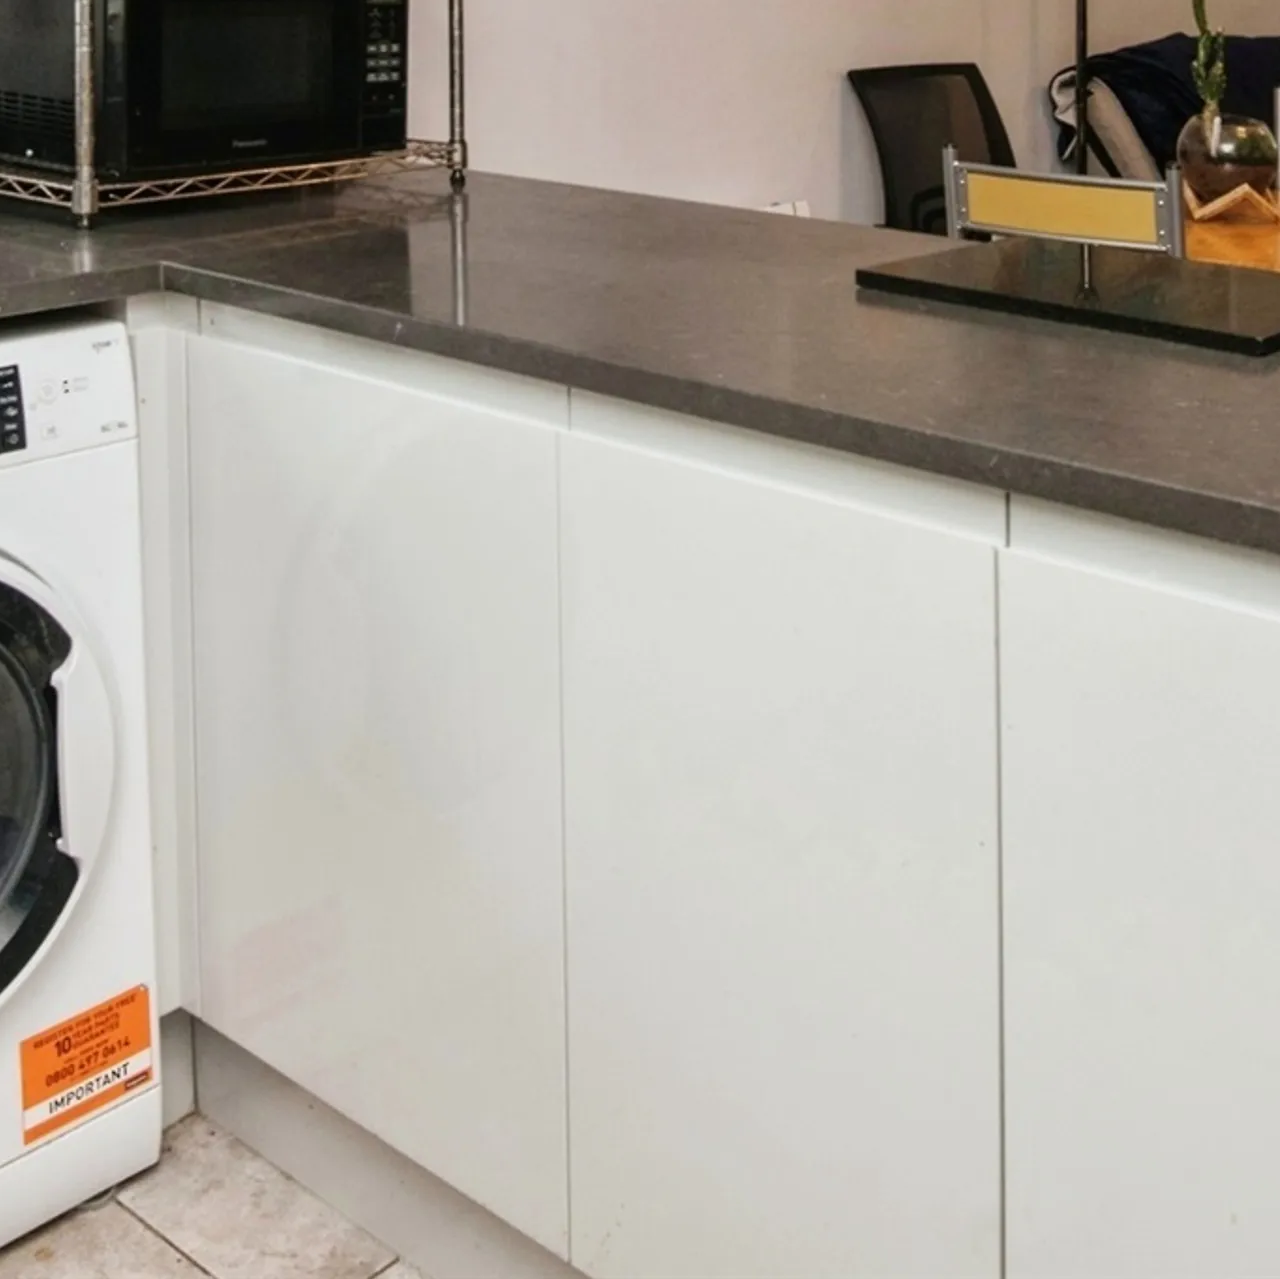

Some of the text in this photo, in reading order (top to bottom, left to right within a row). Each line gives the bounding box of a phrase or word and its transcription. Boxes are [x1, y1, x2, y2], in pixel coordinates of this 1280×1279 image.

[55, 1035, 72, 1057] 10
[45, 1063, 75, 1087] 0800
[48, 1062, 130, 1114] IMPORTANT
